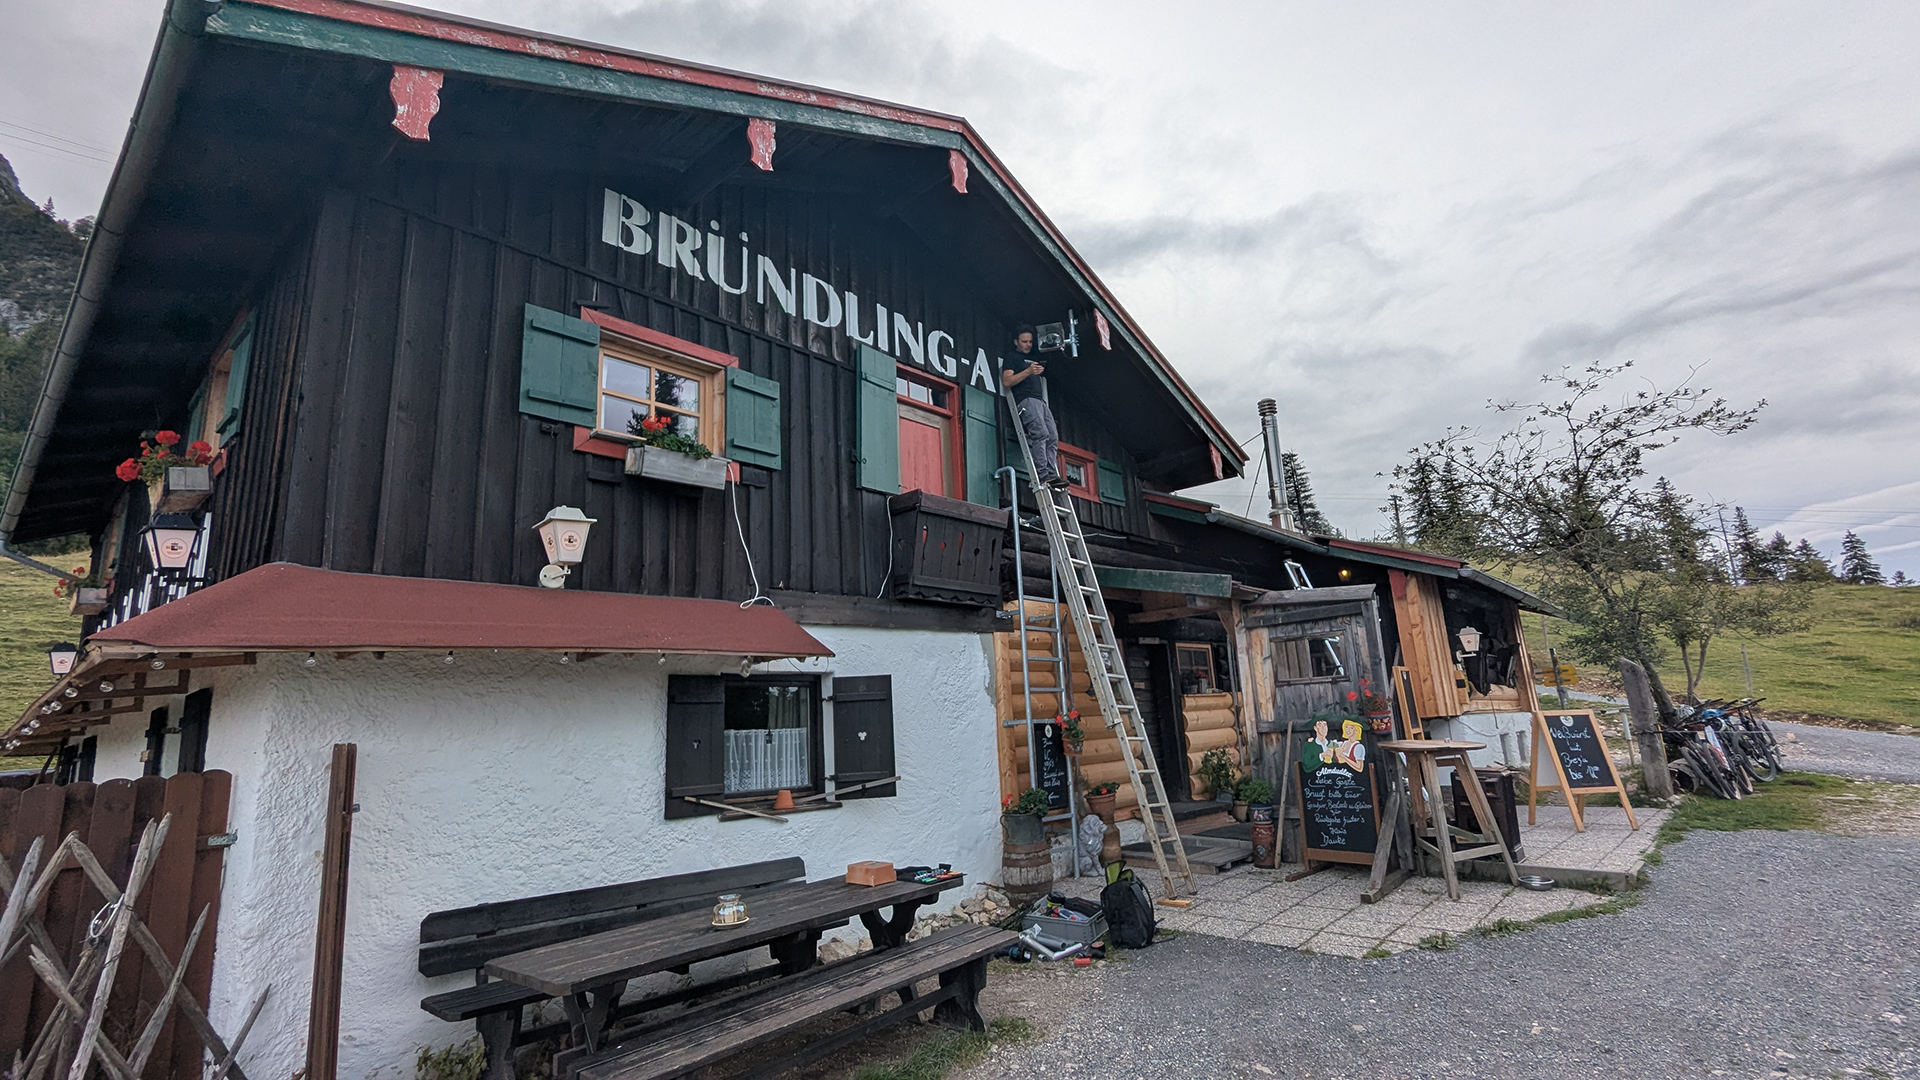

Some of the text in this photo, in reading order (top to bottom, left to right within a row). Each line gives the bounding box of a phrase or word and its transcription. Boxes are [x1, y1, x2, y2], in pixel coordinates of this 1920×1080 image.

[1316, 767, 1354, 778] Almdudler
[1568, 768, 1583, 780] bis
[1334, 776, 1356, 789] Gäste
[1320, 831, 1346, 847] Danke
